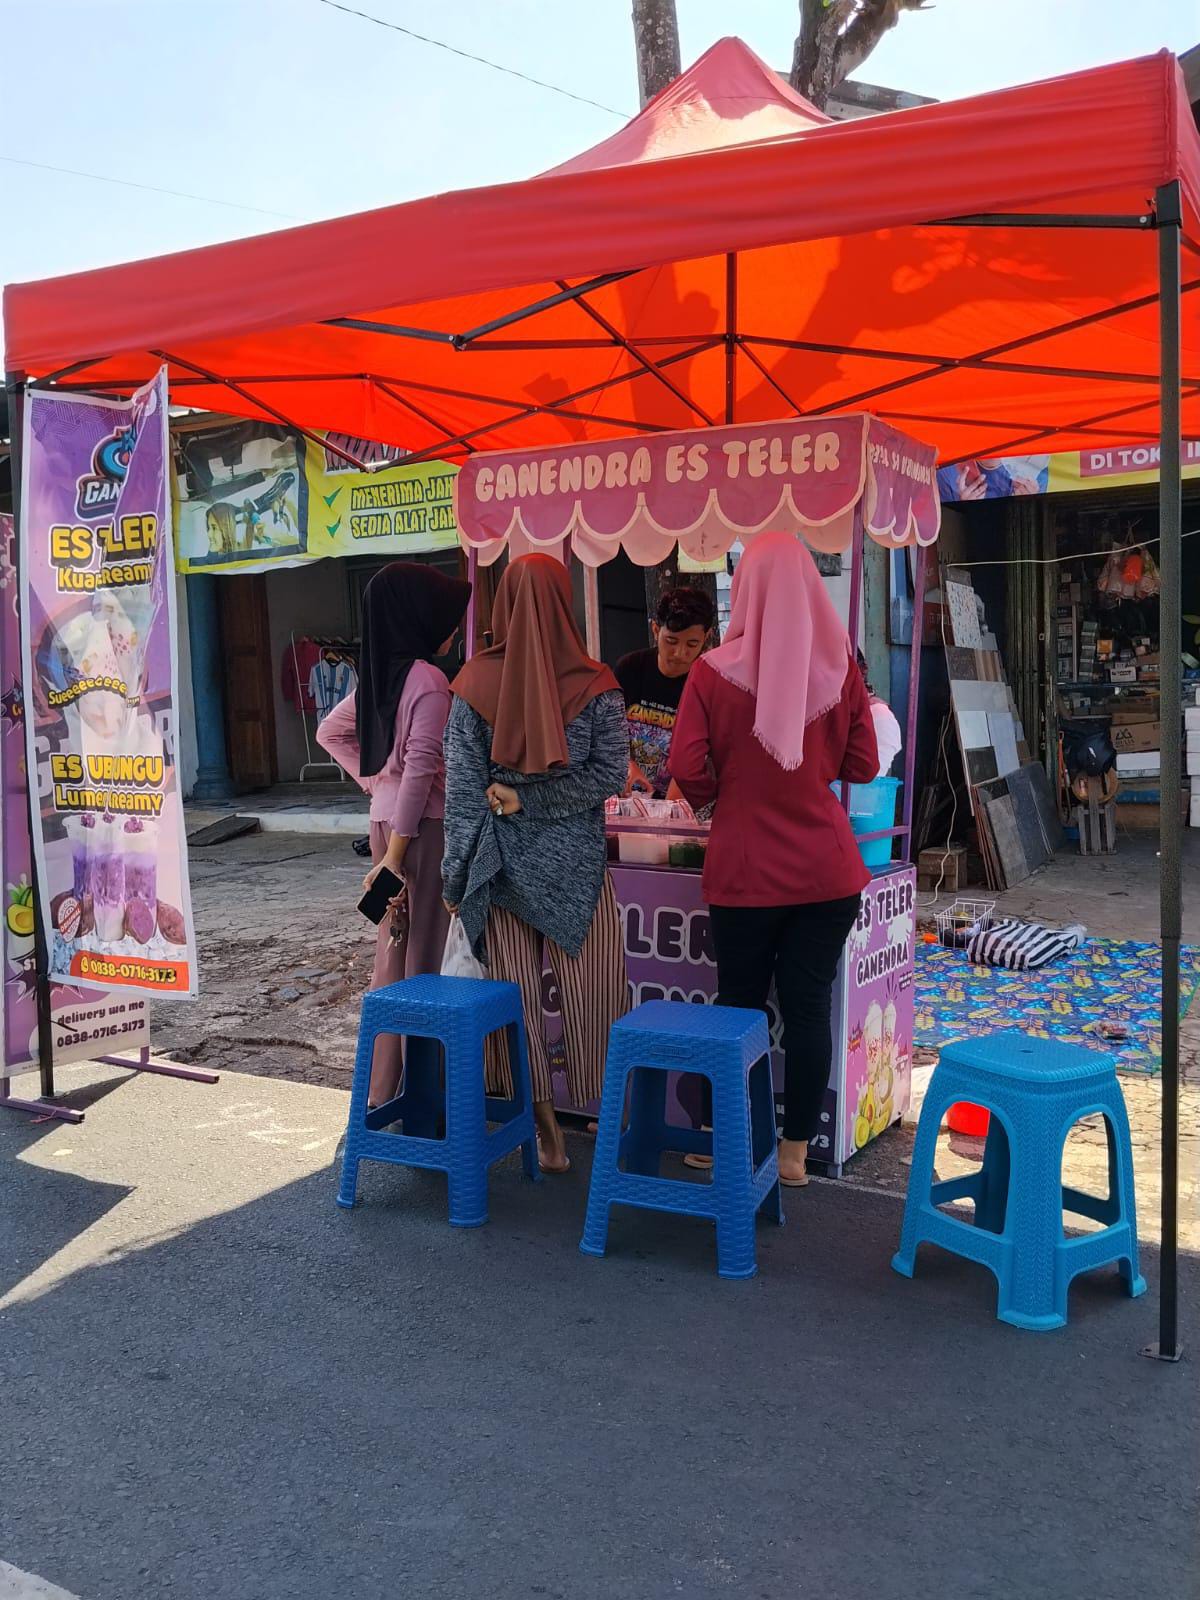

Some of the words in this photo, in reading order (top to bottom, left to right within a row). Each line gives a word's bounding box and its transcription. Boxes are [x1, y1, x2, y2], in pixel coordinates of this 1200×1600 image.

[475, 447, 652, 502] GANENDRA
[665, 442, 709, 483] ES
[723, 432, 841, 478] TELER
[1090, 452, 1112, 470] DI
[351, 479, 424, 511] MENERIMA
[351, 513, 391, 539] SEDIA
[394, 508, 427, 535] ALAT
[52, 527, 92, 559] ES
[51, 754, 83, 780] ES
[857, 896, 871, 932] ES
[876, 882, 913, 923] TELER
[617, 901, 717, 967] LER
[857, 941, 909, 985] GANENDRA
[57, 1007, 106, 1024] delivery
[109, 1004, 126, 1015] wa
[129, 1000, 145, 1011] me
[57, 1018, 145, 1048] 0838-0716-3173
